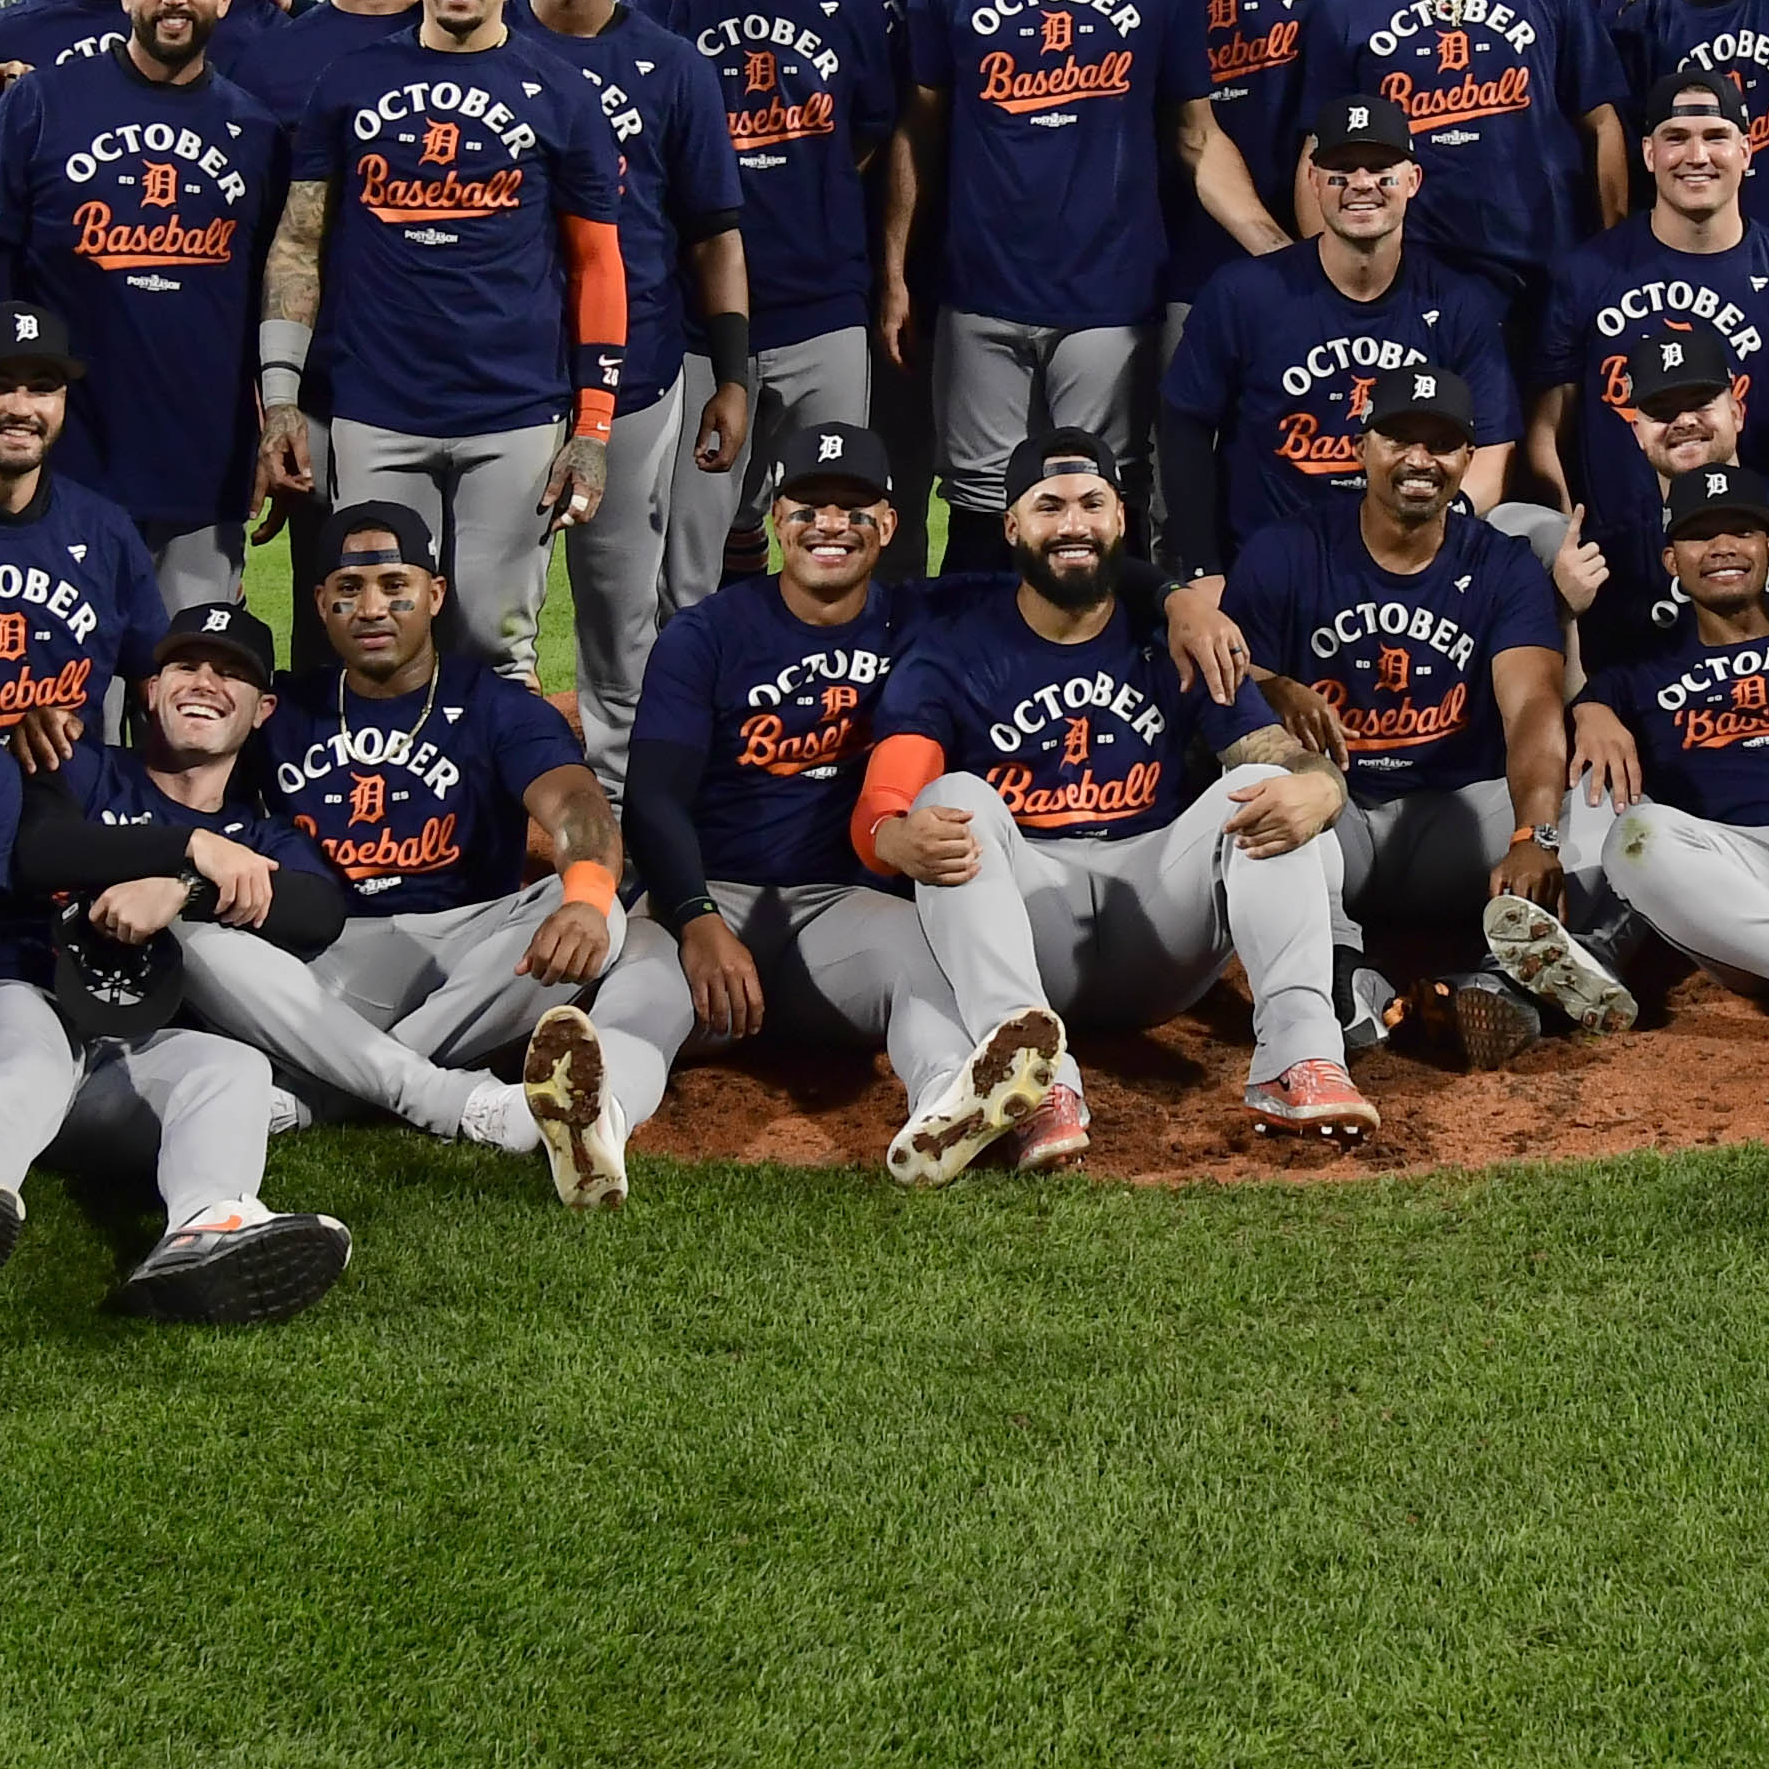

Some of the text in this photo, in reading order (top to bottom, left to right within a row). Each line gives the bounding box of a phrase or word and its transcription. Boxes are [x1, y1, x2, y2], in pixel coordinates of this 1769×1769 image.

[696, 14, 841, 82] CTOBER
[980, 51, 1134, 101] Baseball
[354, 81, 537, 160] OCTOBER
[1381, 65, 1532, 119] Baseball
[65, 122, 247, 205] OCTOBER
[357, 152, 524, 210] Baseball
[72, 201, 237, 257] Baseball
[1596, 280, 1763, 362] OCTOBER
[602, 367, 620, 386] 28
[1311, 602, 1476, 672] OCTOBER
[989, 670, 1167, 754] OCTOBER
[277, 726, 461, 801] OCTOBER
[985, 760, 1162, 817] Baseball
